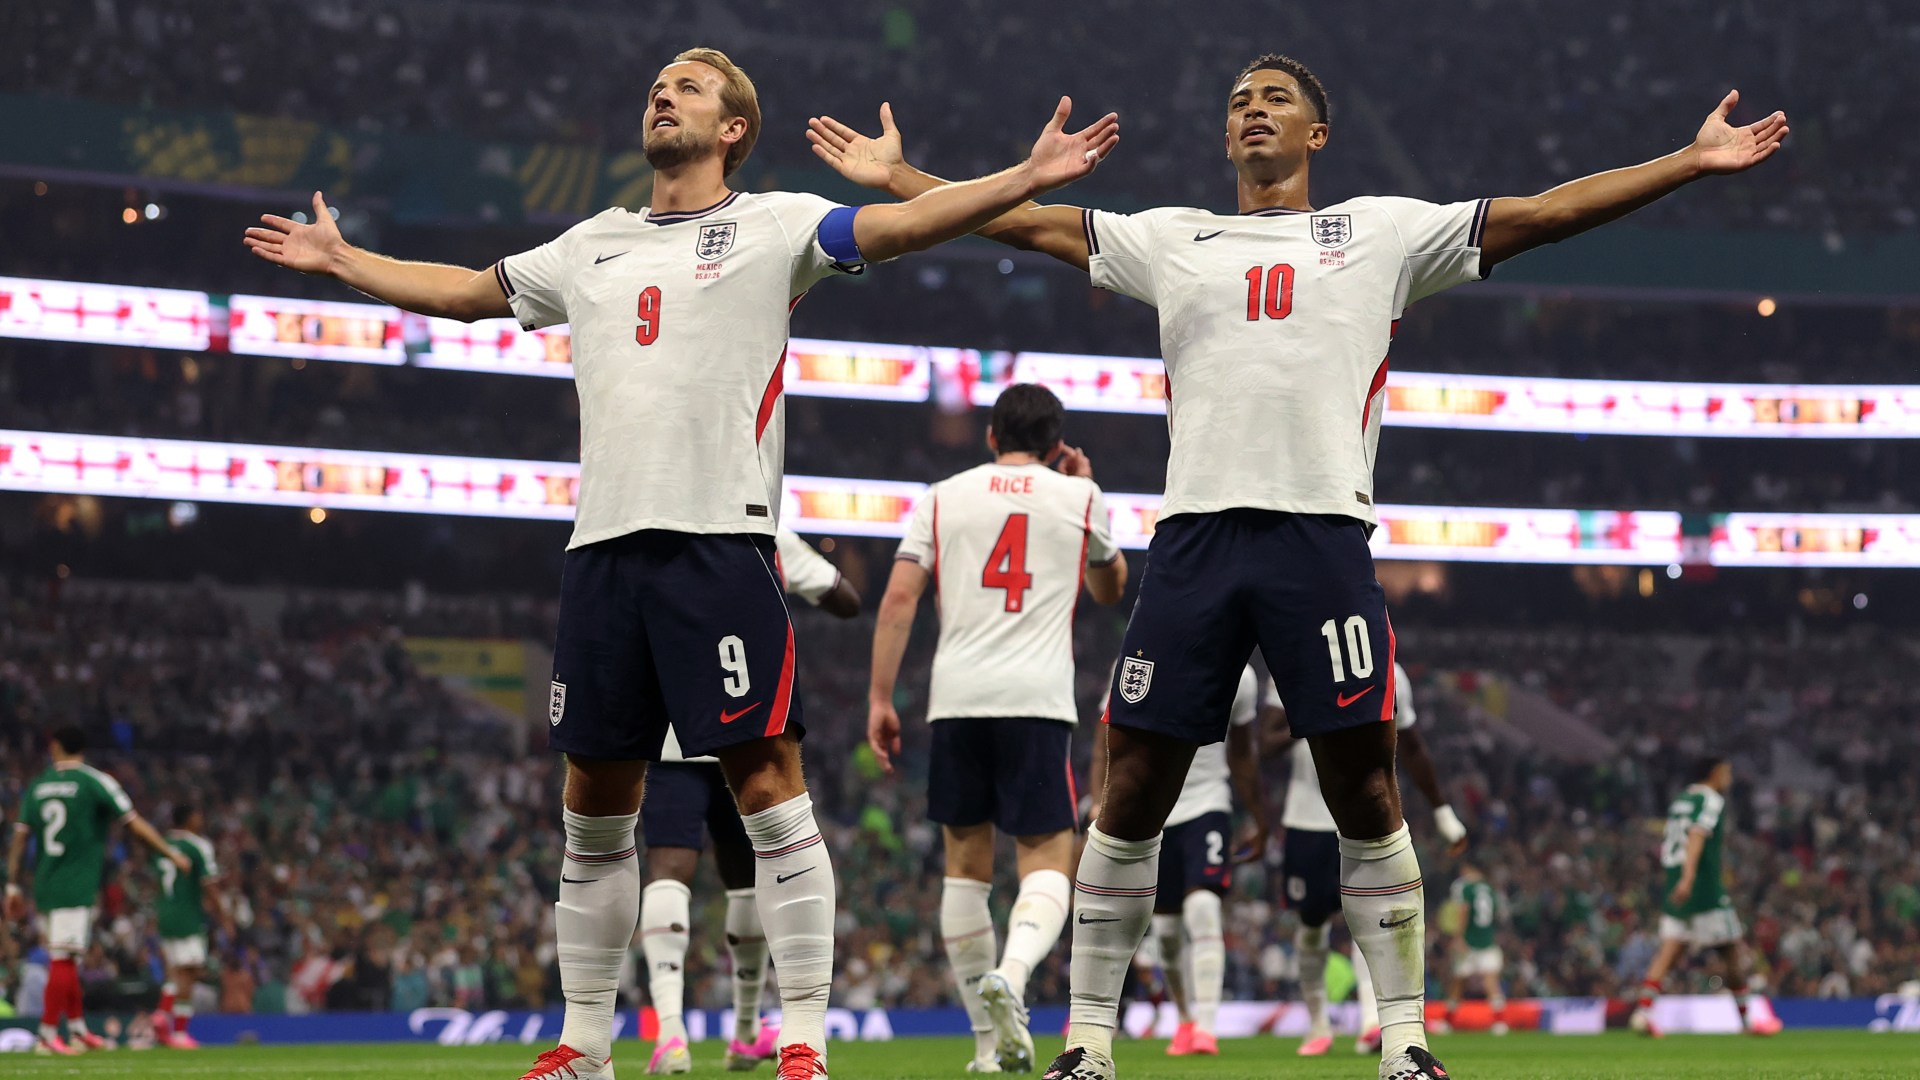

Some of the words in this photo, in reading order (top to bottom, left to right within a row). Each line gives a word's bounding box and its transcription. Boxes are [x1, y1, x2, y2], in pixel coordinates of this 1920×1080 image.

[1320, 250, 1345, 259] MEXICO
[636, 285, 662, 346] 9
[1245, 263, 1295, 321] 10
[989, 476, 1035, 494] RICE
[982, 513, 1033, 613] 4
[718, 634, 750, 698] 9
[1321, 615, 1374, 683] 10
[40, 798, 67, 856] 2
[1205, 830, 1224, 865] 2
